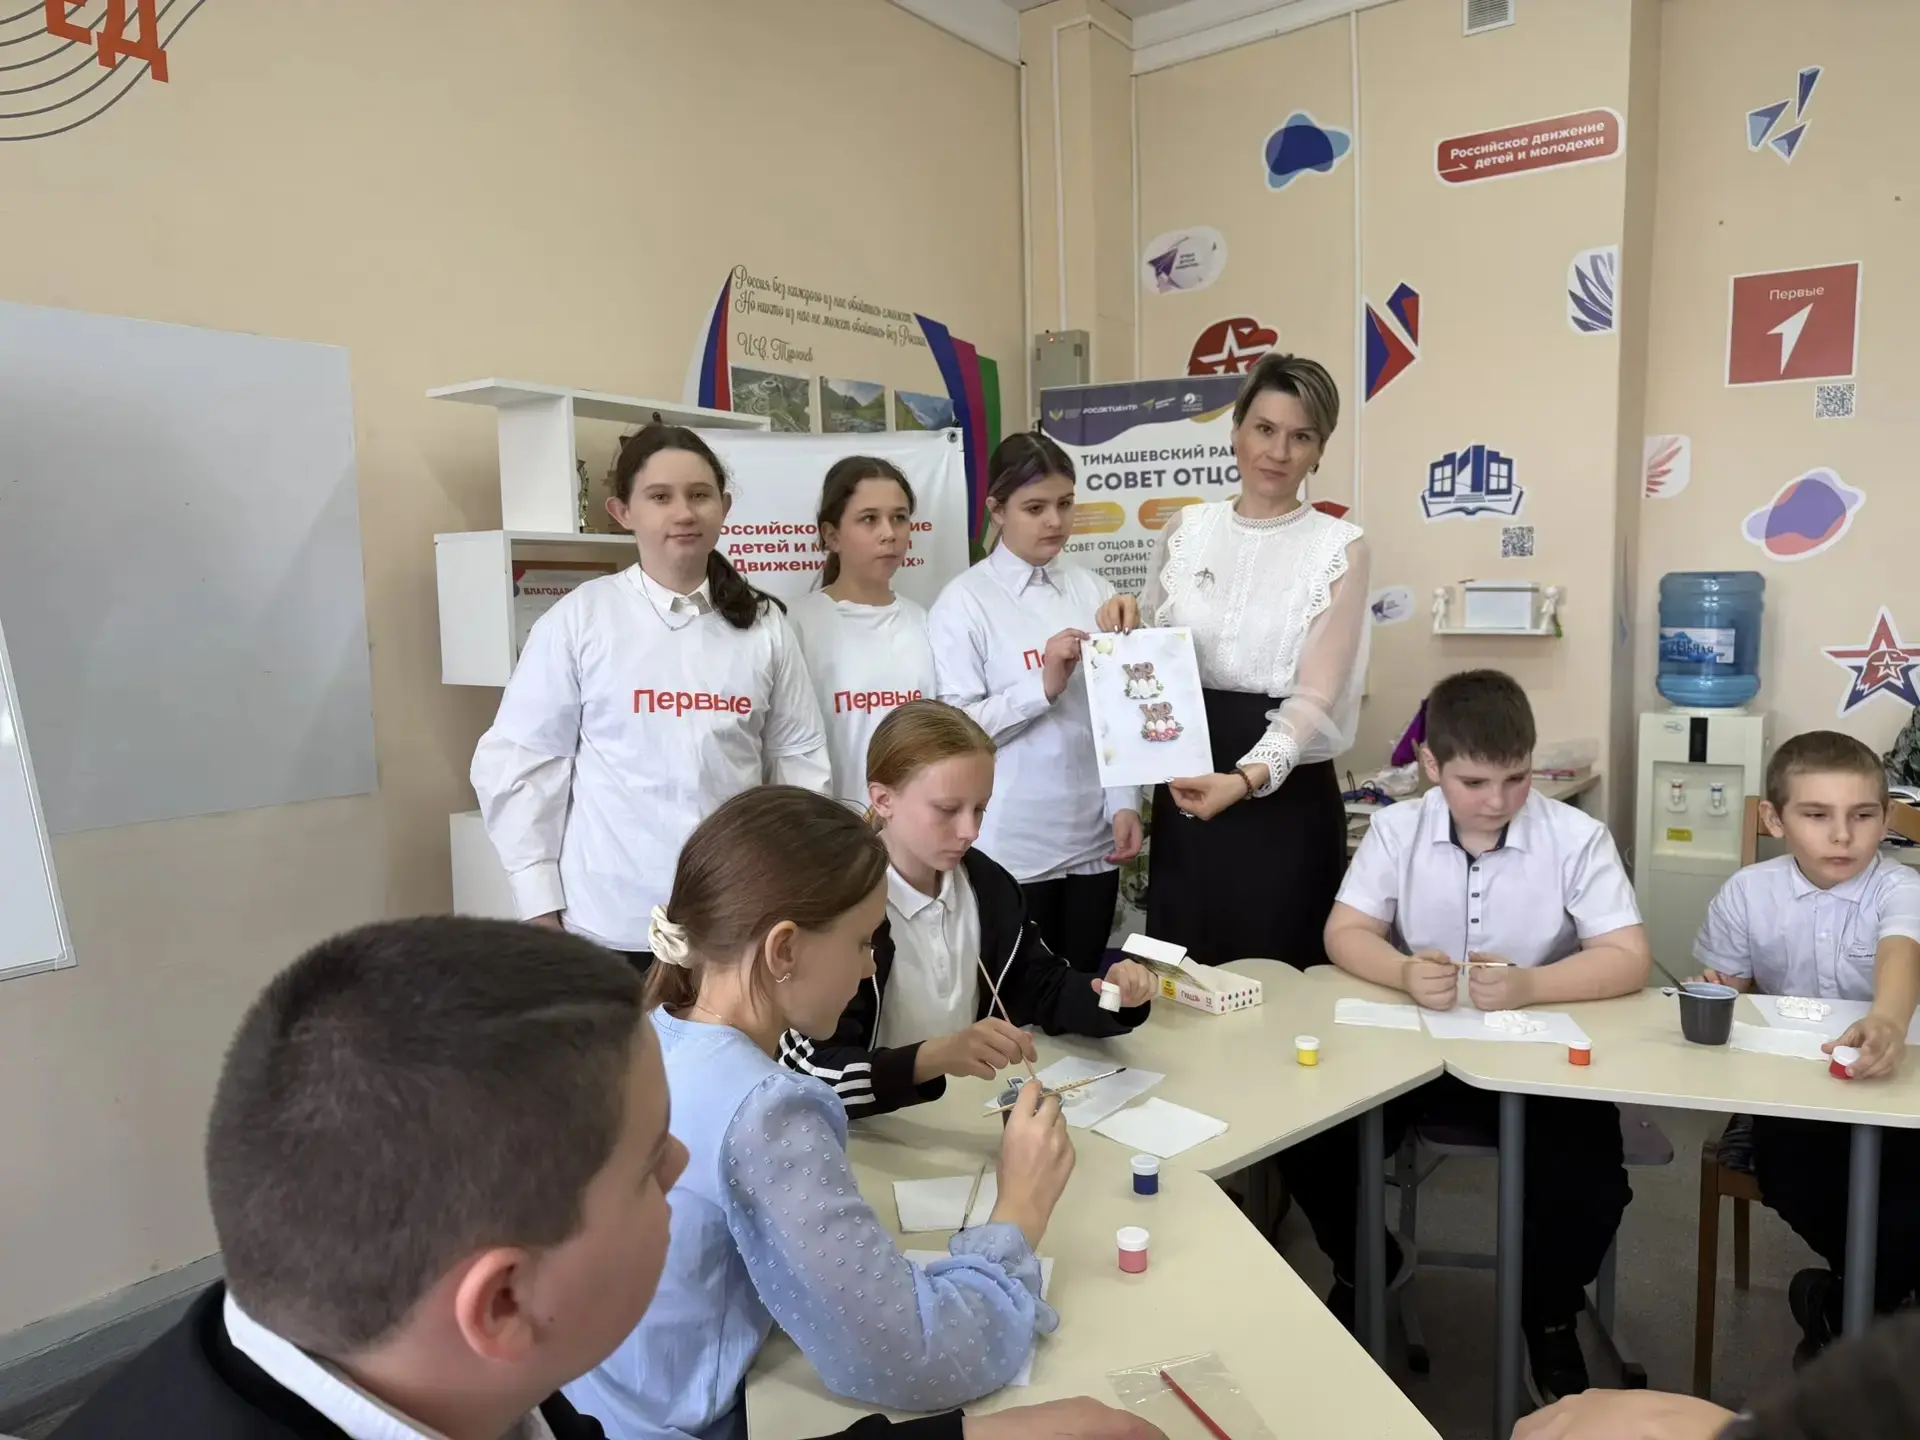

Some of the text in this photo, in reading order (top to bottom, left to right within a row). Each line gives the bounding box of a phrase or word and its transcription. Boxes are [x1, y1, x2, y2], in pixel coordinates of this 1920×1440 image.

[1450, 121, 1605, 160] Российское движение
[1474, 135, 1605, 170] детей и молодежи
[1769, 286, 1825, 301] Первые
[1081, 444, 1204, 467] ТИМАШЕВСКИЙ
[1086, 469, 1167, 491] СОВЕТ
[719, 521, 820, 536] оссийско
[728, 539, 789, 556] детей
[794, 542, 806, 552] и
[1063, 542, 1095, 553] СОВЕТ
[1097, 540, 1136, 551] ОТЦОВ
[1137, 539, 1144, 548] В
[733, 557, 826, 575] Движени
[523, 587, 576, 596] БЛАГОДАР
[633, 688, 752, 717] Первые
[834, 688, 923, 714] Первые
